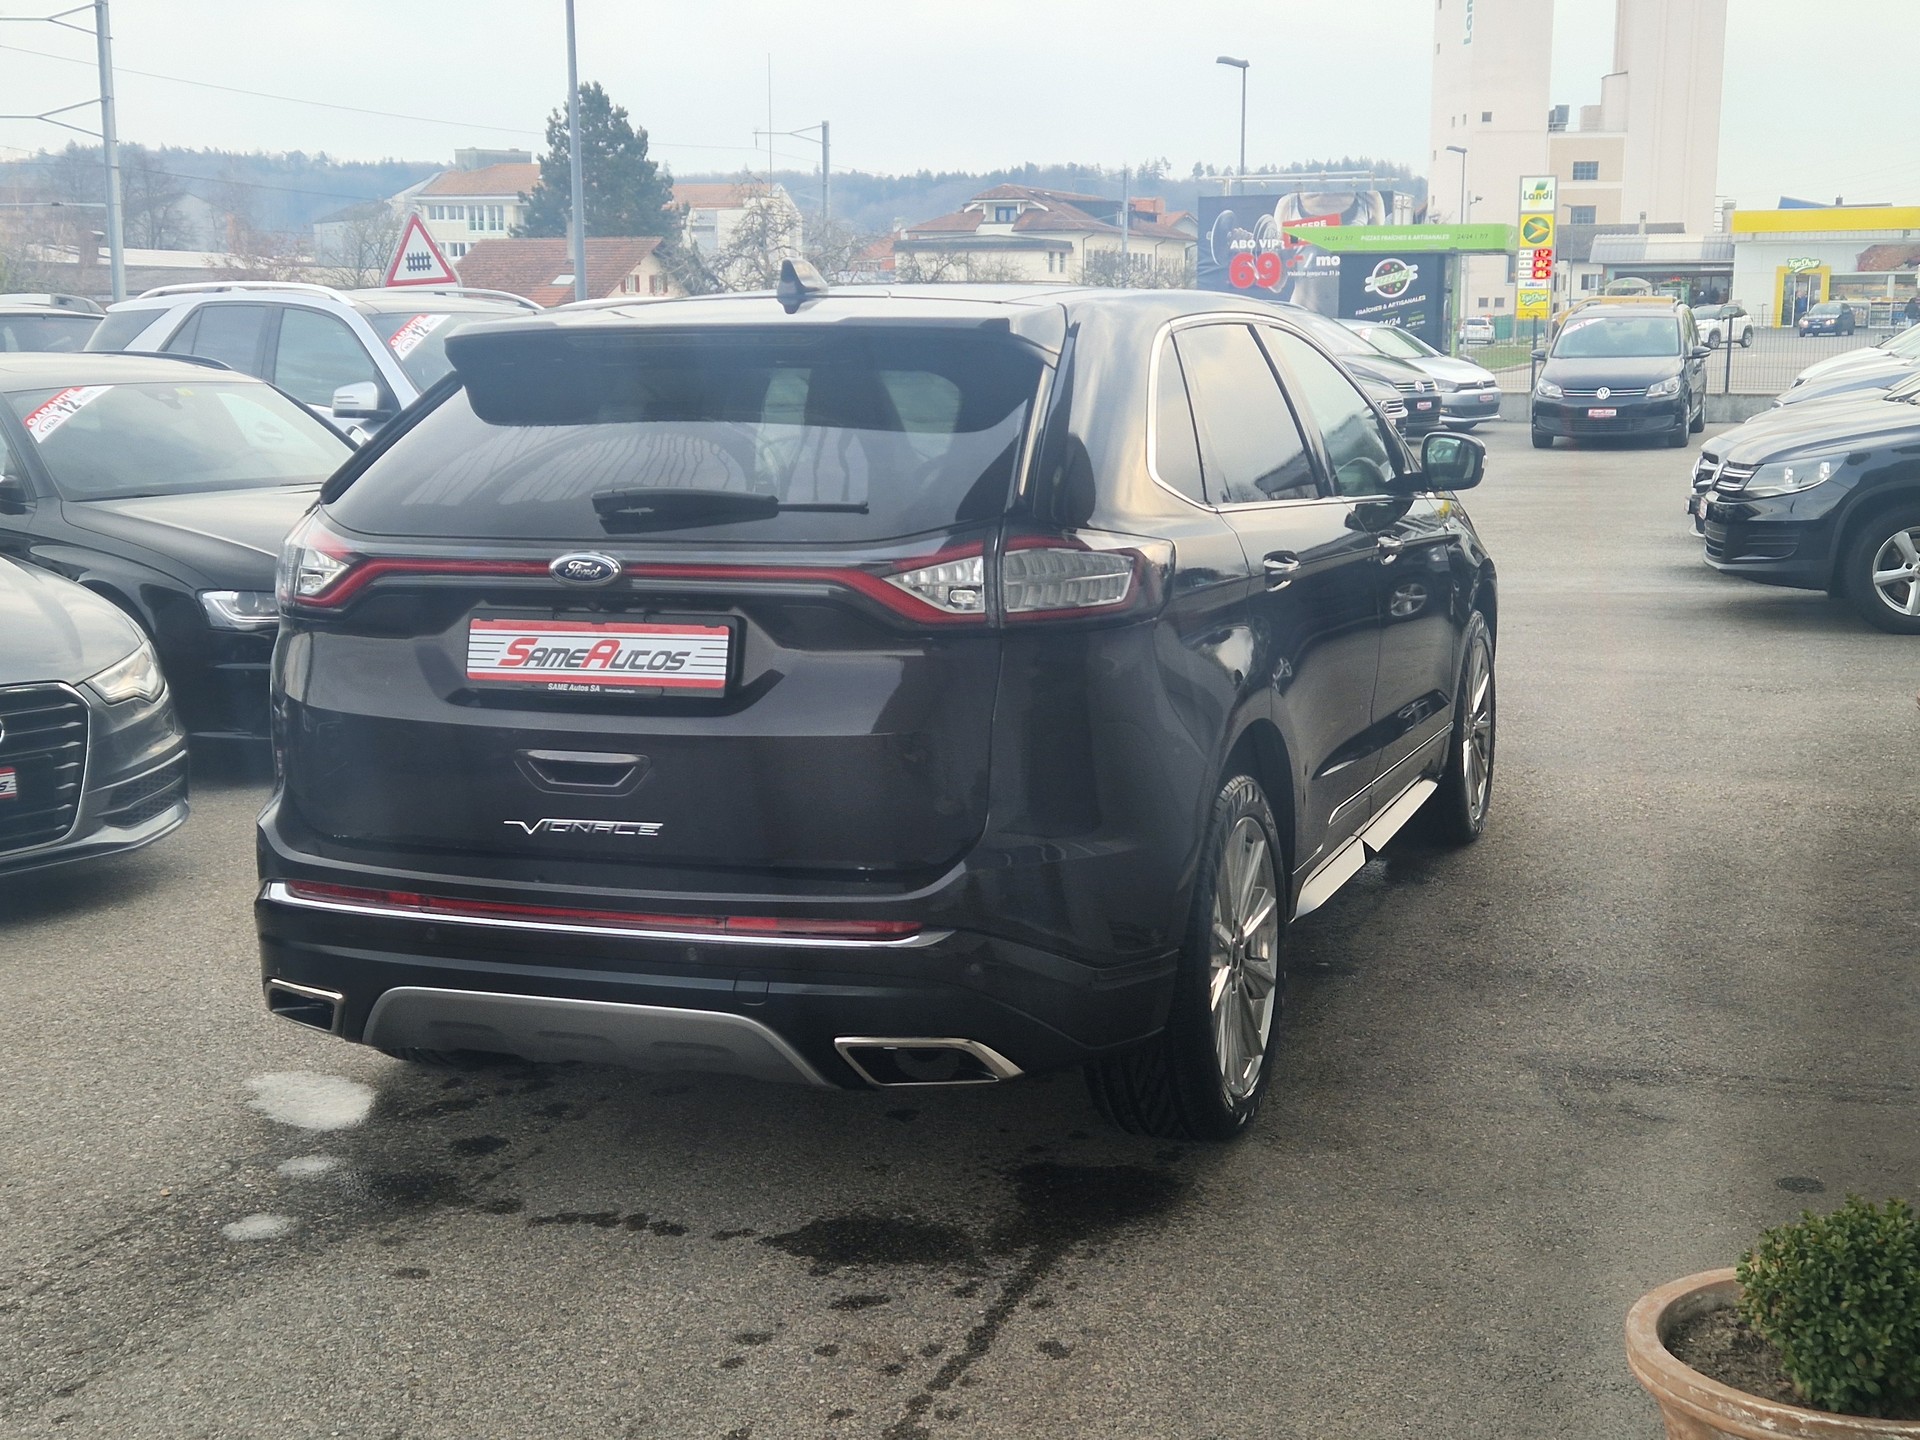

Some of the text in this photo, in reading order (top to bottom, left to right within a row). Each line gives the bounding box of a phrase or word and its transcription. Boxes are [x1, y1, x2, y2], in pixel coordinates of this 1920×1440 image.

[1523, 190, 1553, 200] Landi
[1230, 239, 1256, 249] ABO
[1388, 295, 1426, 308] ARTISANALES
[411, 325, 429, 337] 12
[26, 387, 75, 426] GARANTIE
[57, 400, 82, 413] 12
[565, 560, 602, 578] Ford
[547, 683, 568, 691] SAME
[568, 683, 589, 692] Autos
[590, 684, 600, 692] SA
[503, 818, 664, 836] VIGNALE
